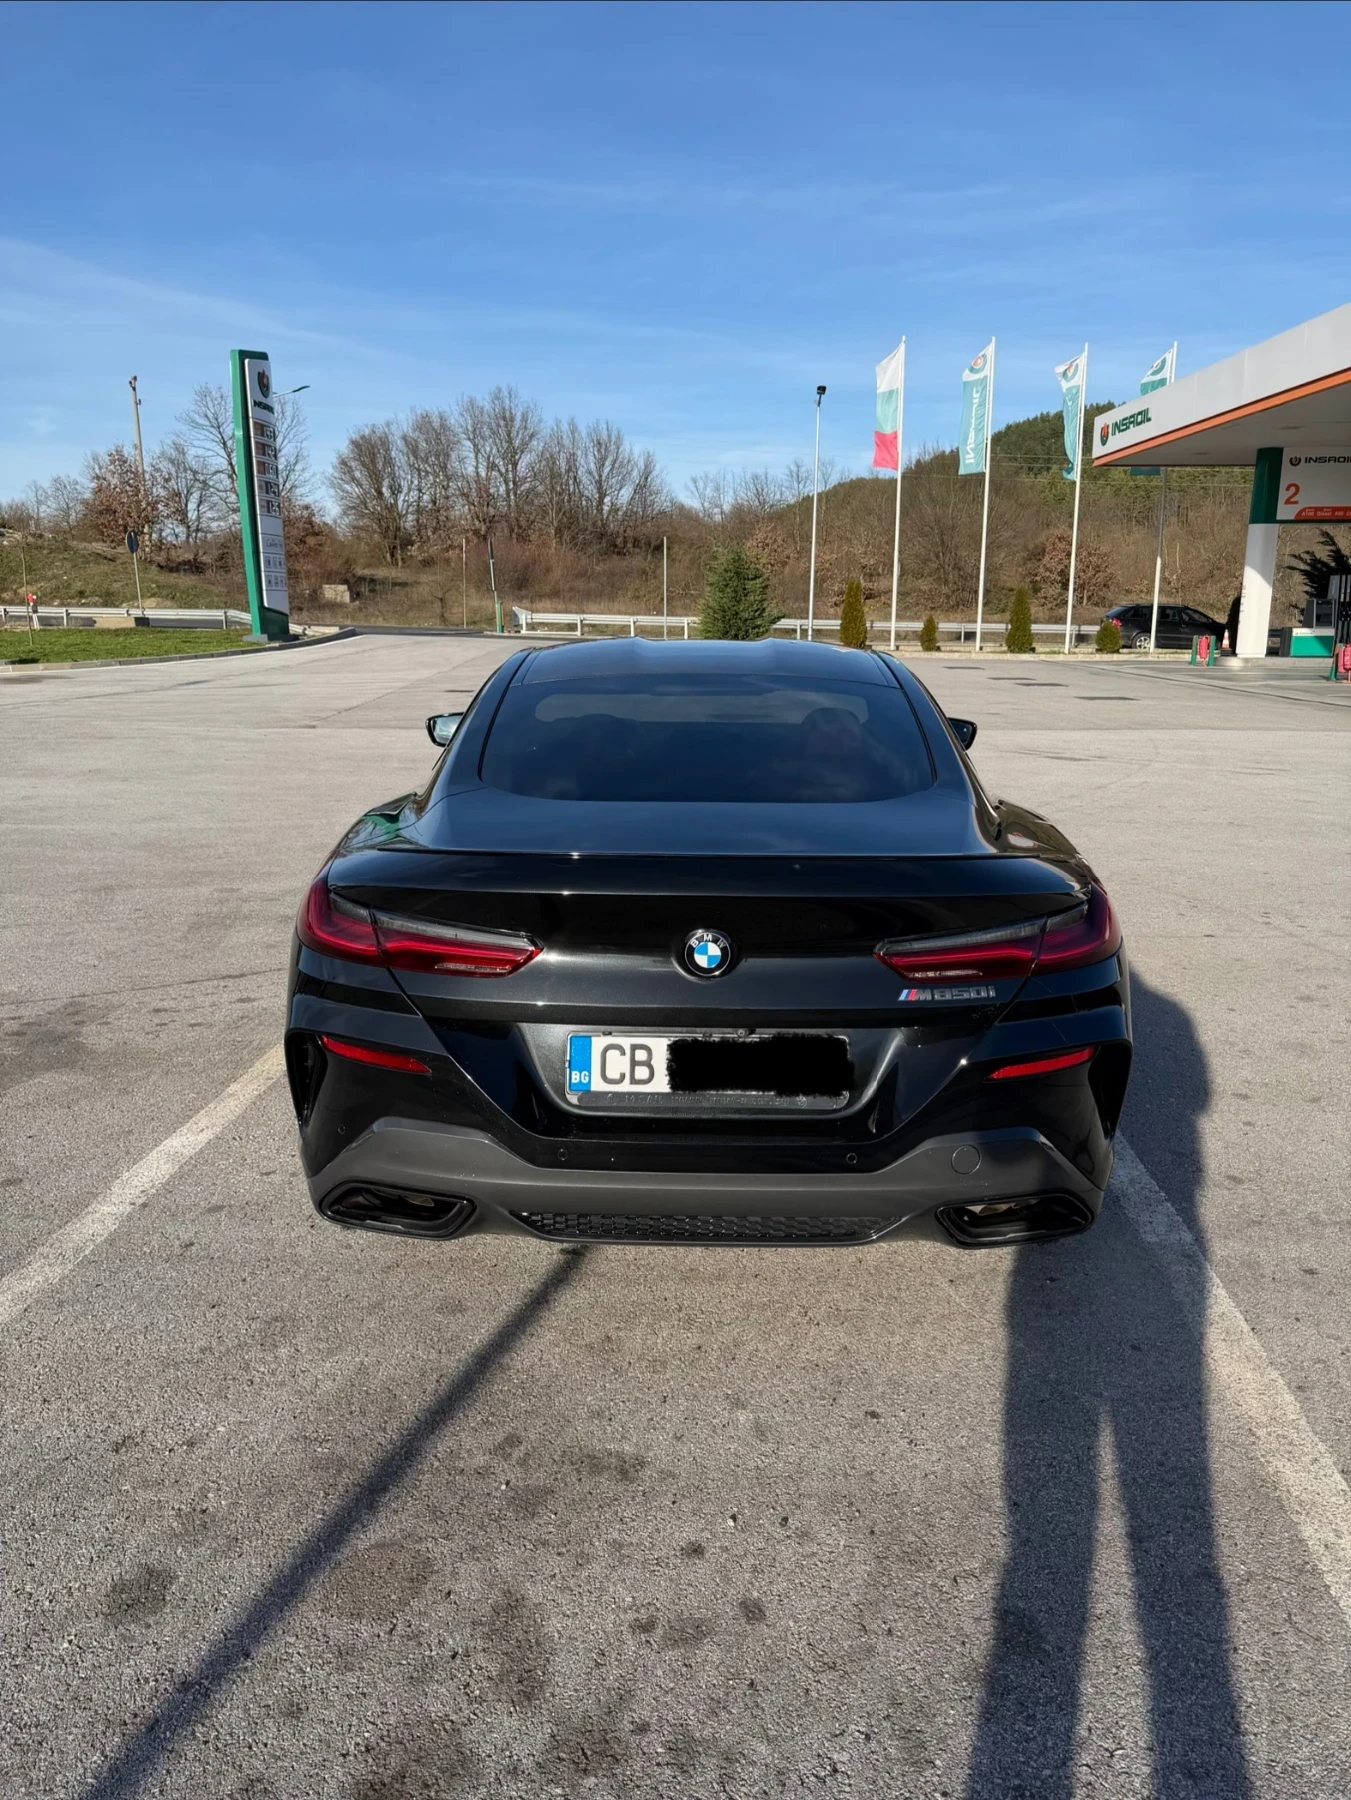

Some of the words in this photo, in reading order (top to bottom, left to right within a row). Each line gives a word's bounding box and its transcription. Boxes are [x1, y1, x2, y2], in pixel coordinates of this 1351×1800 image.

[1111, 407, 1152, 437] INSAOIL
[1284, 483, 1300, 505] 2
[690, 934, 727, 949] BMW
[899, 985, 996, 1001] M850i
[600, 1043, 655, 1086] CB
[571, 1070, 590, 1084] BG
